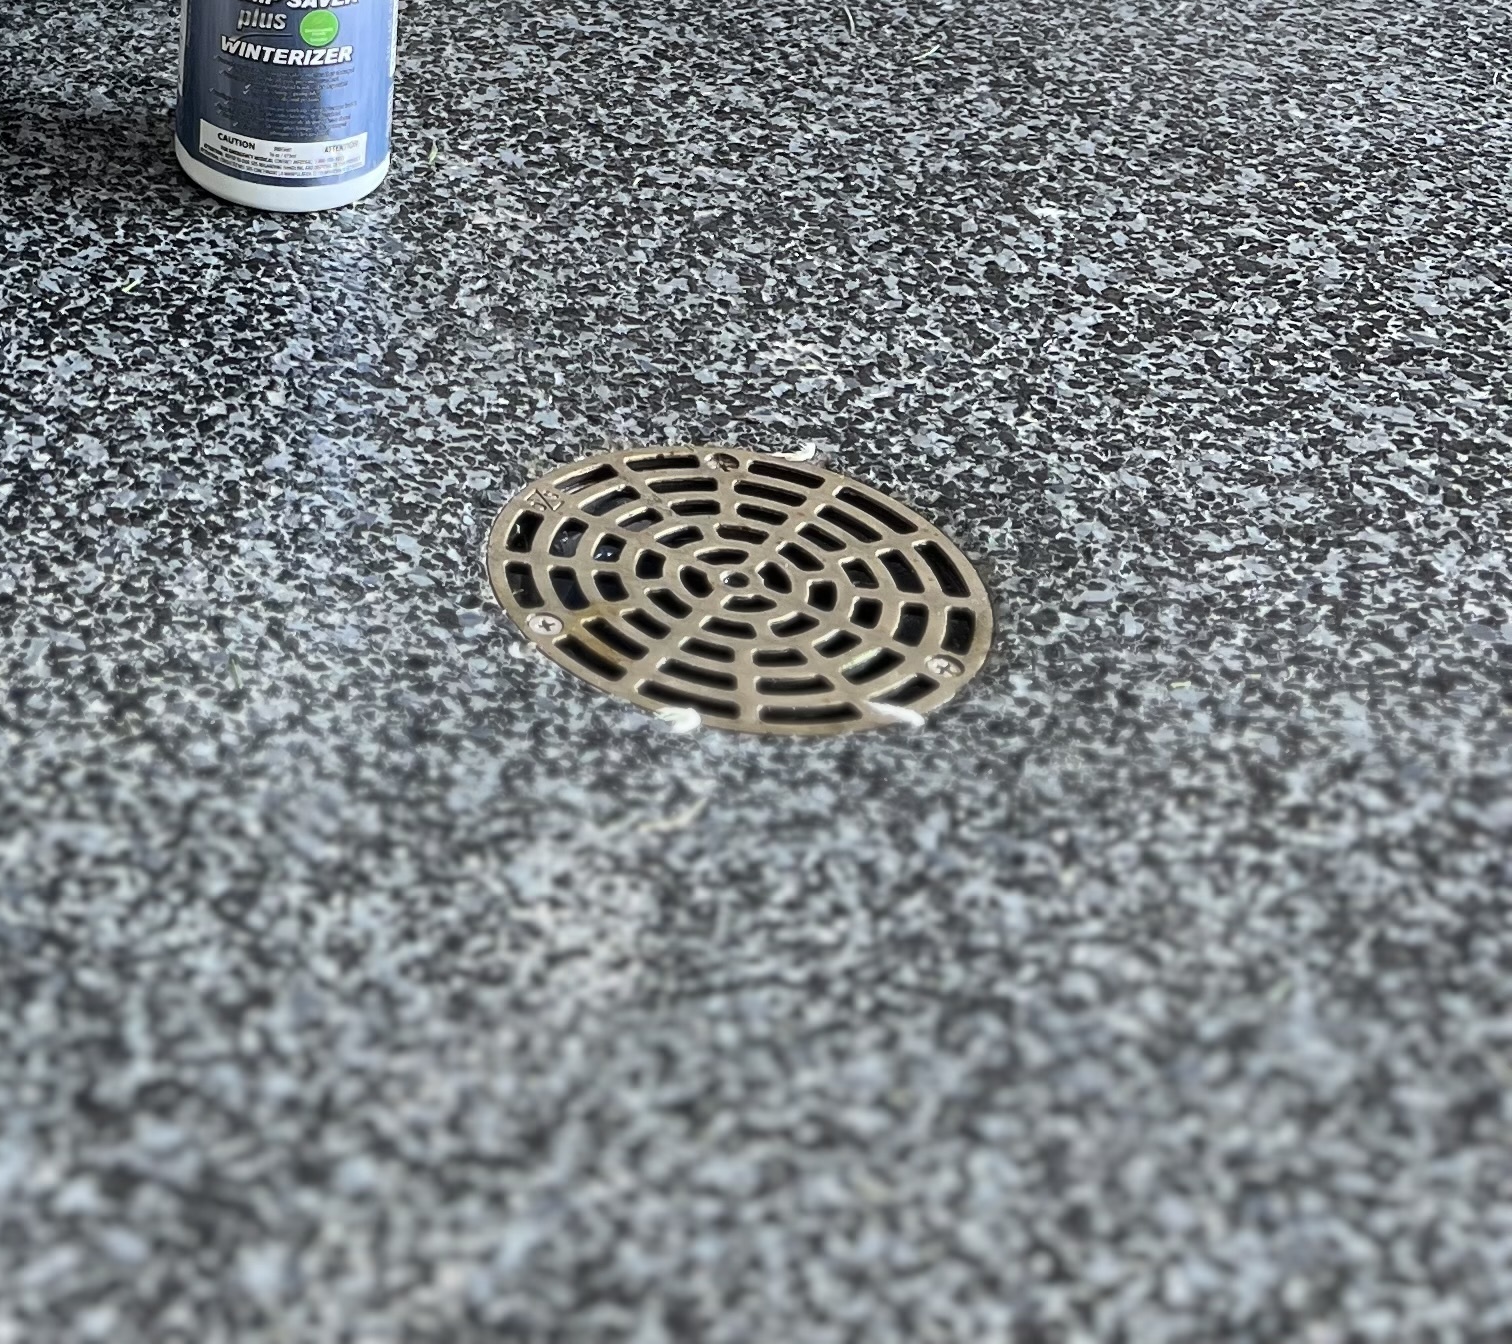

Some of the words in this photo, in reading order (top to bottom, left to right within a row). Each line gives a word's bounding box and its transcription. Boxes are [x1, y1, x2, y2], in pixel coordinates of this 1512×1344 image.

[238, 8, 288, 31] plus
[220, 34, 354, 66] WINTERIZER
[217, 132, 256, 151] CAUTION
